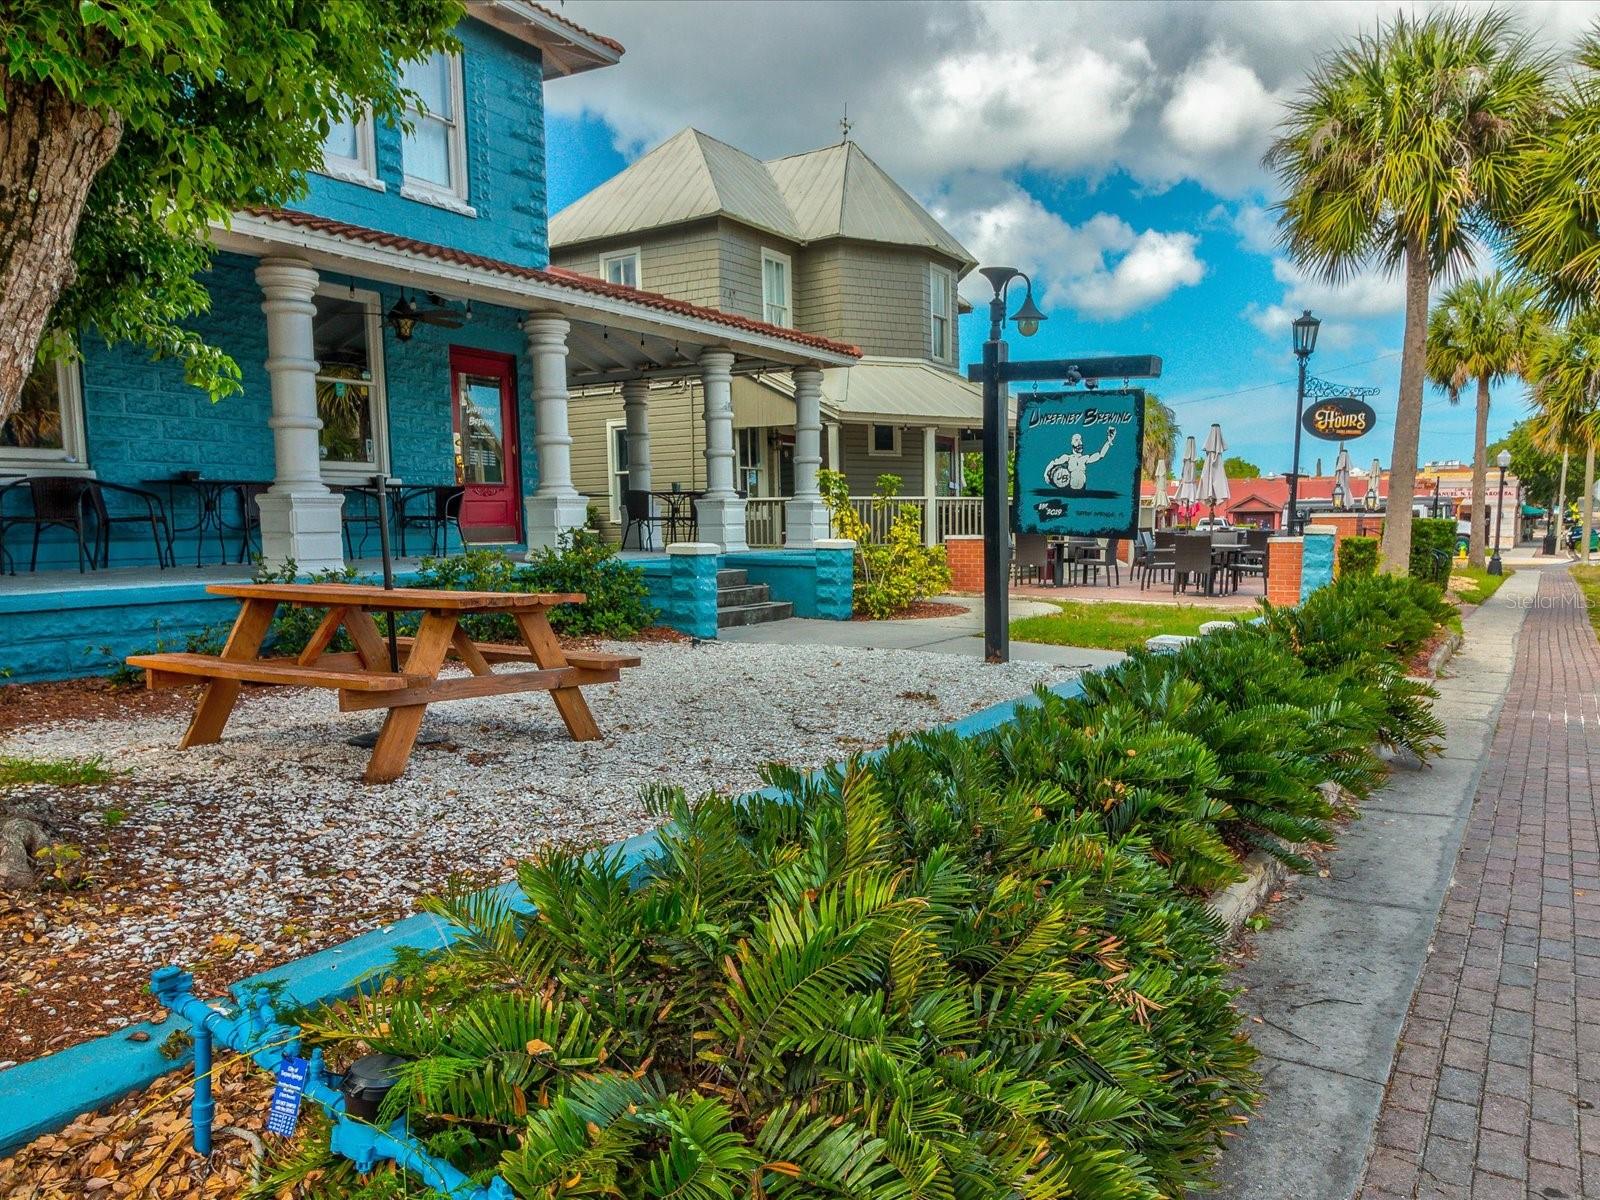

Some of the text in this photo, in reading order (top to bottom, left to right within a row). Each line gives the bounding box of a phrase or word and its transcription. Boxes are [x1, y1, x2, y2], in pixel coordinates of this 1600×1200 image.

[1029, 407, 1132, 428] UNREFINED BREWING
[1315, 410, 1366, 430] HOURS
[1046, 508, 1063, 516] 2019
